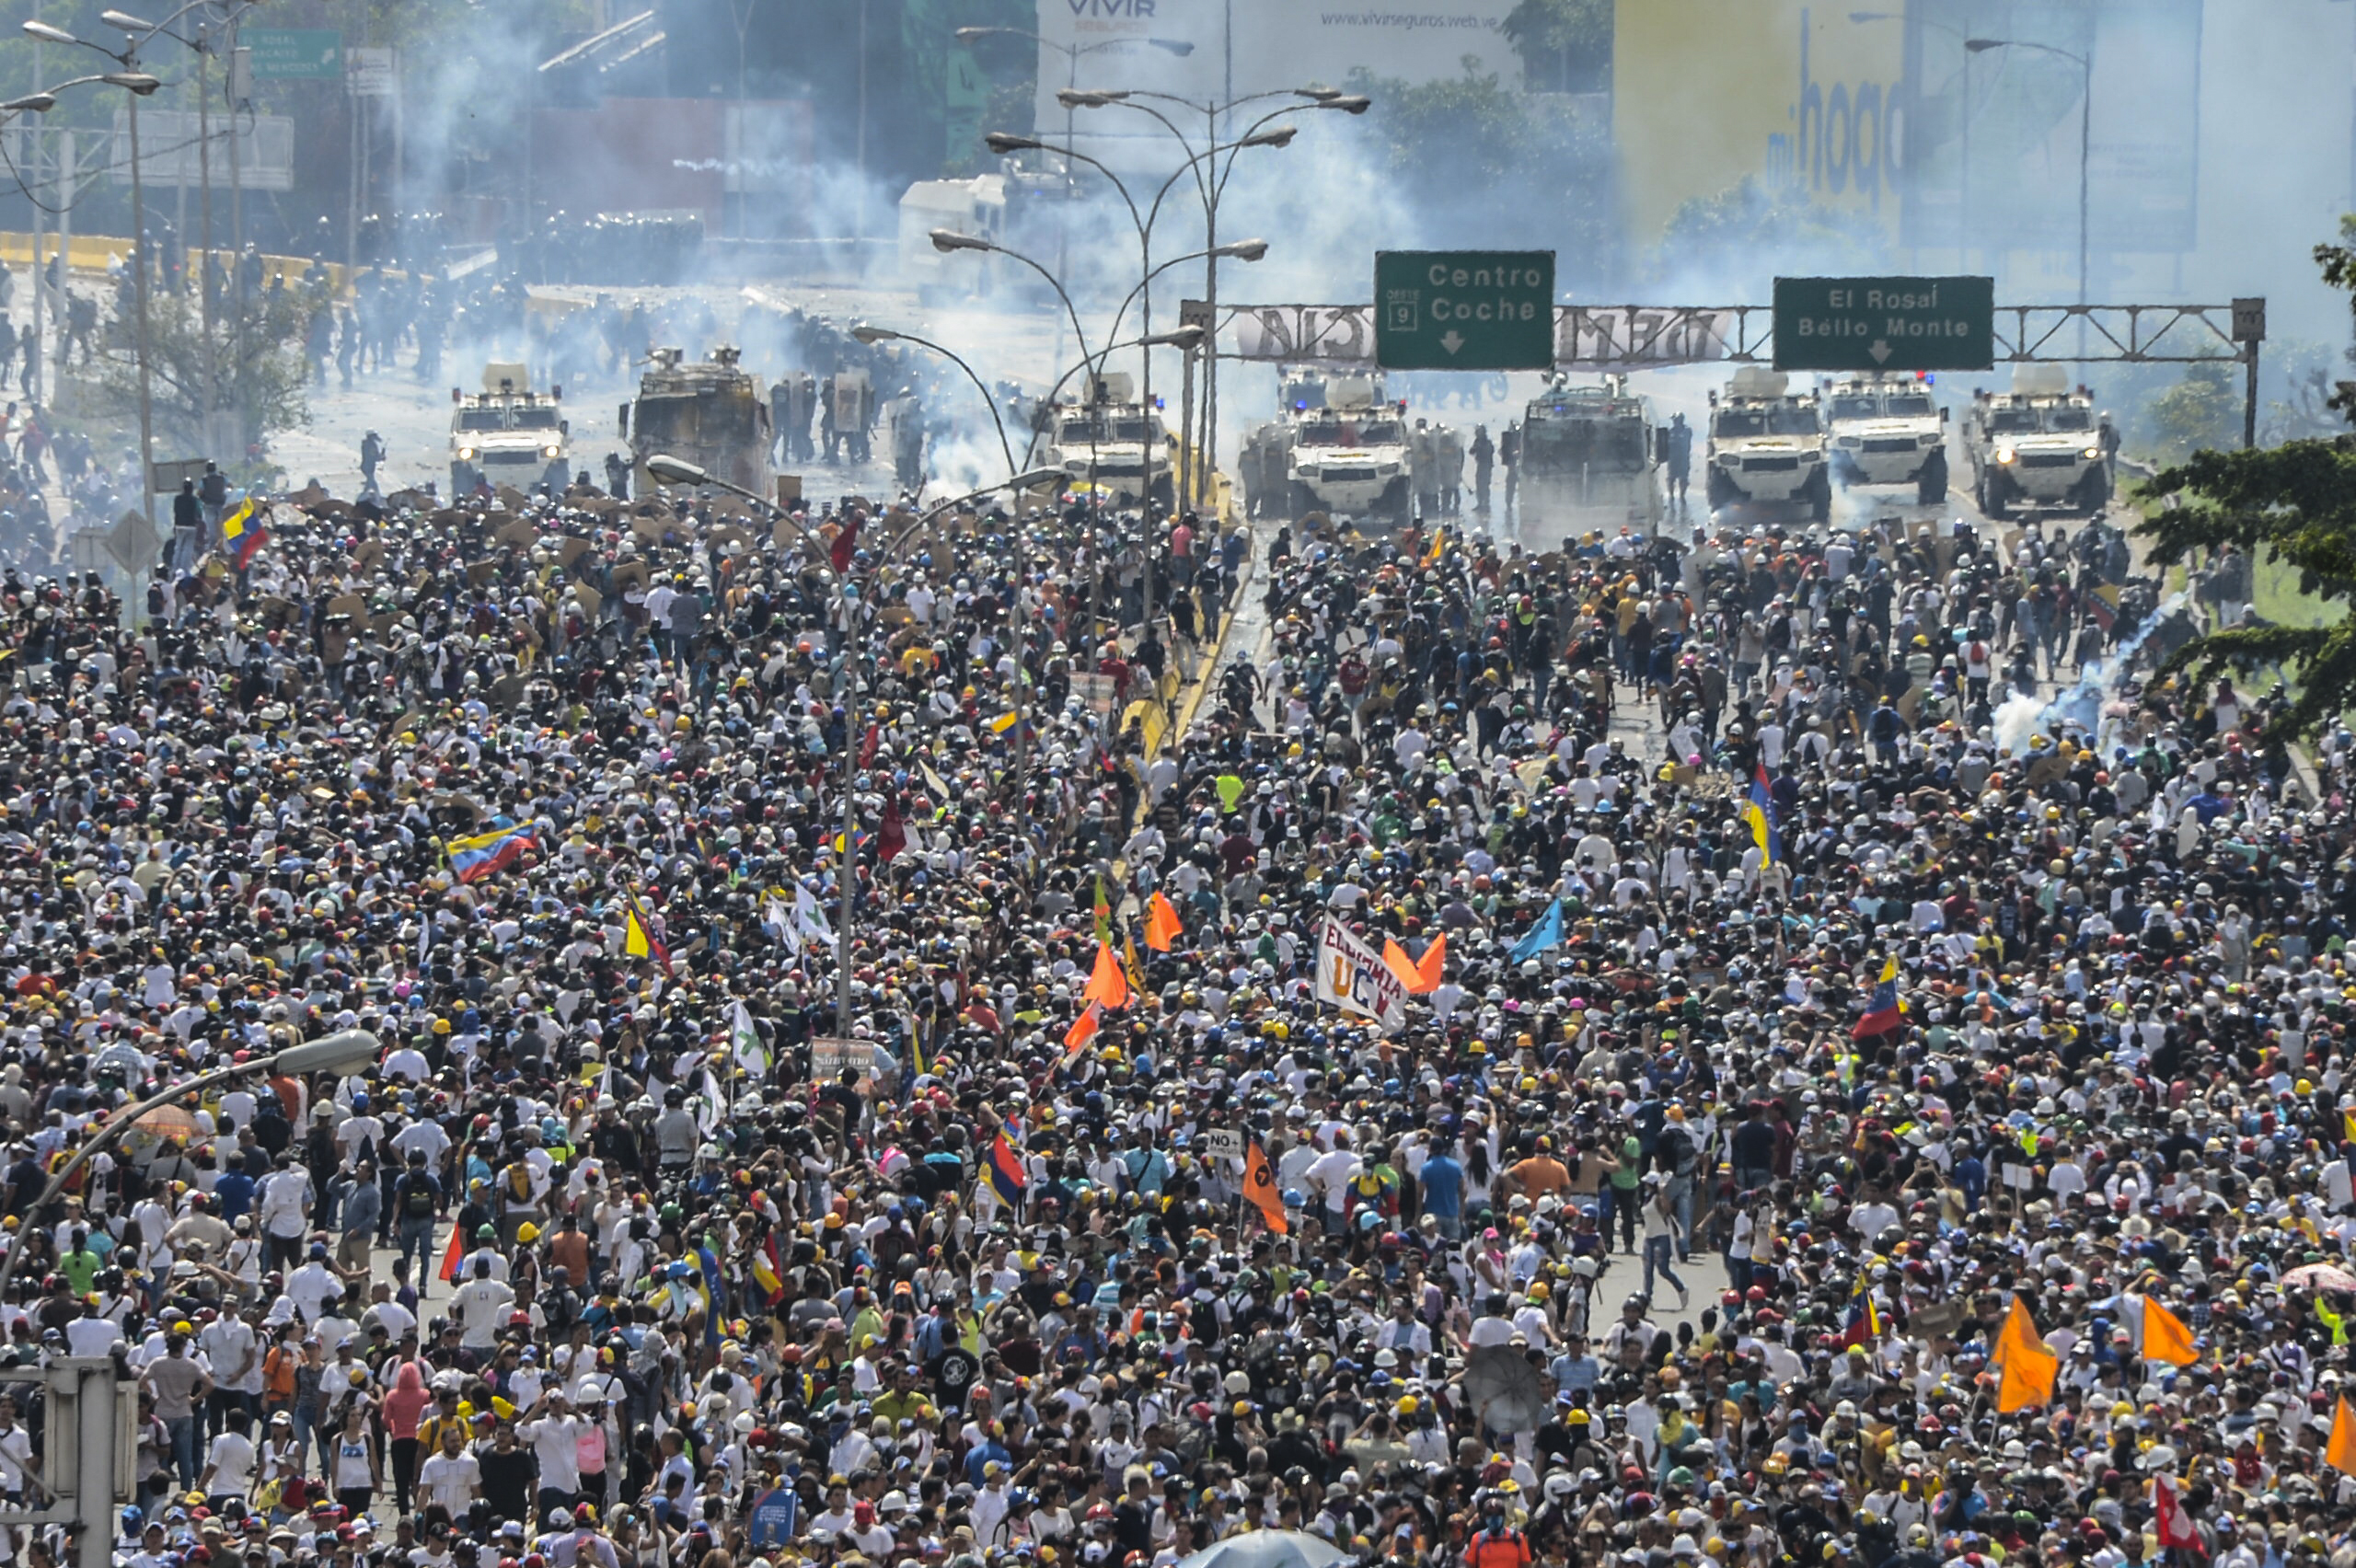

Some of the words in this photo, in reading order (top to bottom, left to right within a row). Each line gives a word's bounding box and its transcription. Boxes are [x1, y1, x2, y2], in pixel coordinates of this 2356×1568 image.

[1068, 0, 1155, 17] VIVIR
[1429, 264, 1540, 287] Centro
[1829, 290, 1854, 308] El
[1867, 283, 1938, 309] Rosal
[1398, 306, 1409, 323] 9
[1431, 297, 1535, 321] Coche
[1798, 318, 1868, 337] Bello
[1887, 318, 1969, 338] Monte
[1210, 1135, 1230, 1147] NO
